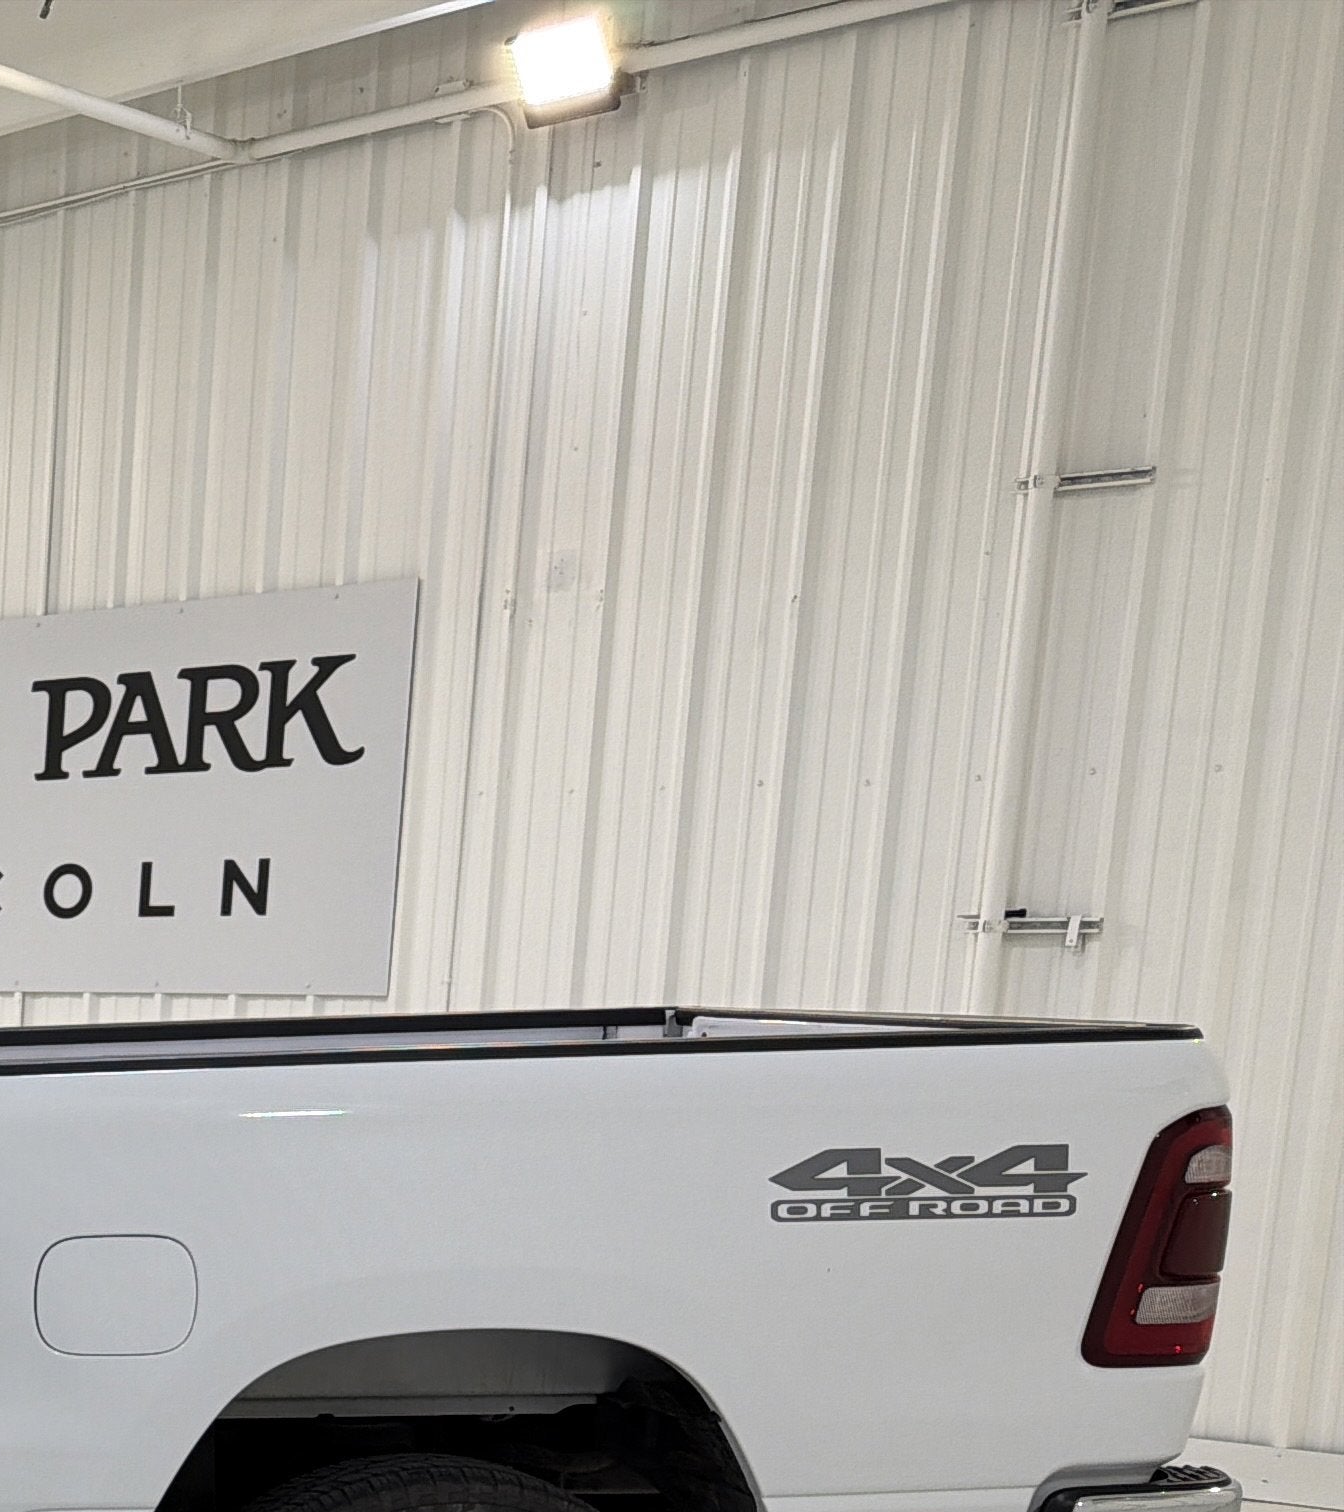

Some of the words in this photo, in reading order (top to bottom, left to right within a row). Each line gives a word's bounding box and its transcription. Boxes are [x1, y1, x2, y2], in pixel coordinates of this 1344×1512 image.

[32, 653, 365, 781] PARK
[777, 1201, 895, 1219] OFF
[909, 1197, 1070, 1217] ROAD
